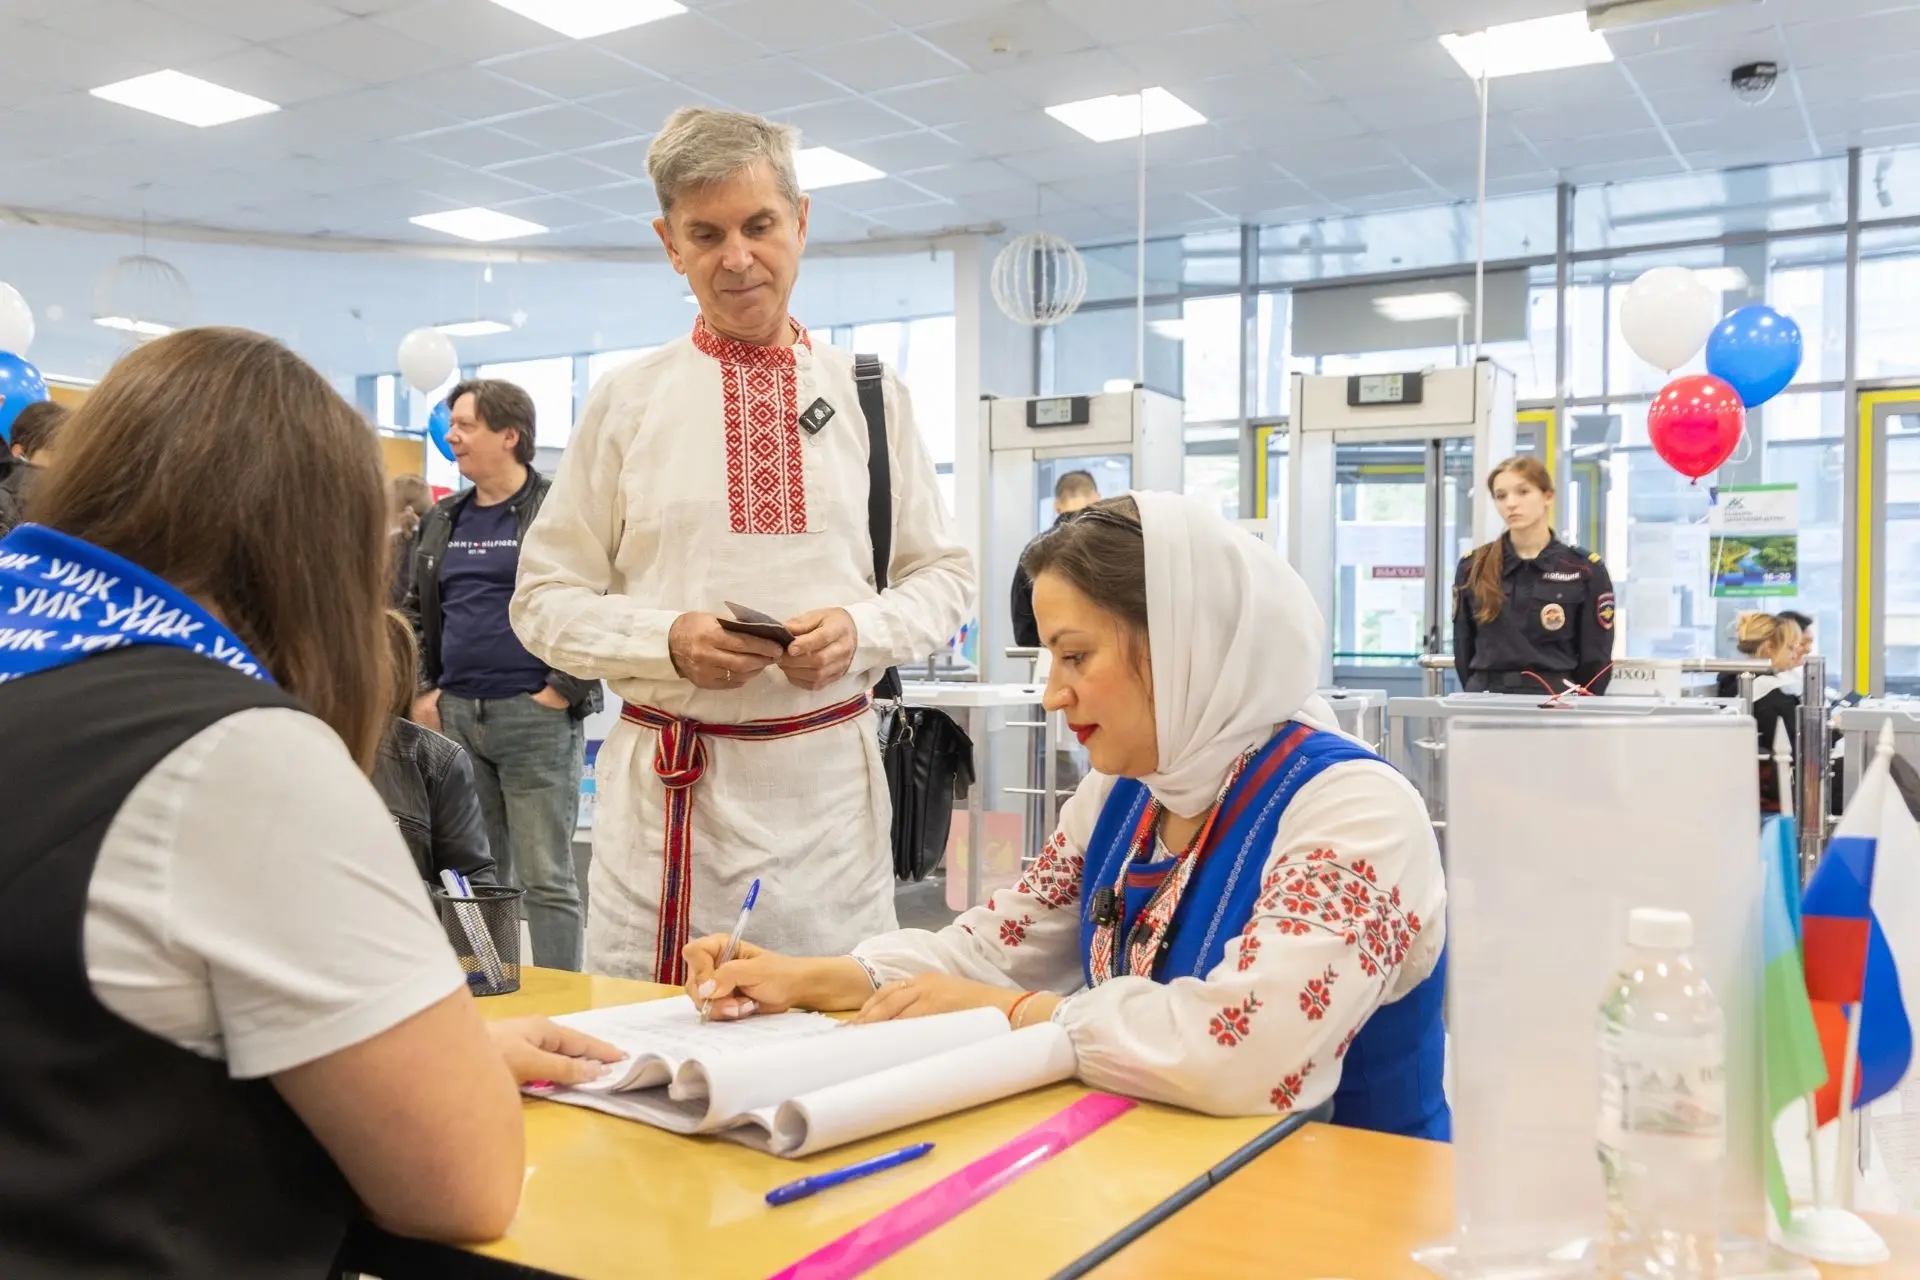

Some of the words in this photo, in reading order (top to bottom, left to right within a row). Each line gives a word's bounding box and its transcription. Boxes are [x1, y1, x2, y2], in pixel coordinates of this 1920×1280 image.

[40, 557, 121, 602] УИК
[8, 586, 92, 621] УИК
[0, 628, 58, 651] ИК
[1613, 667, 1656, 682] ЫХОД
